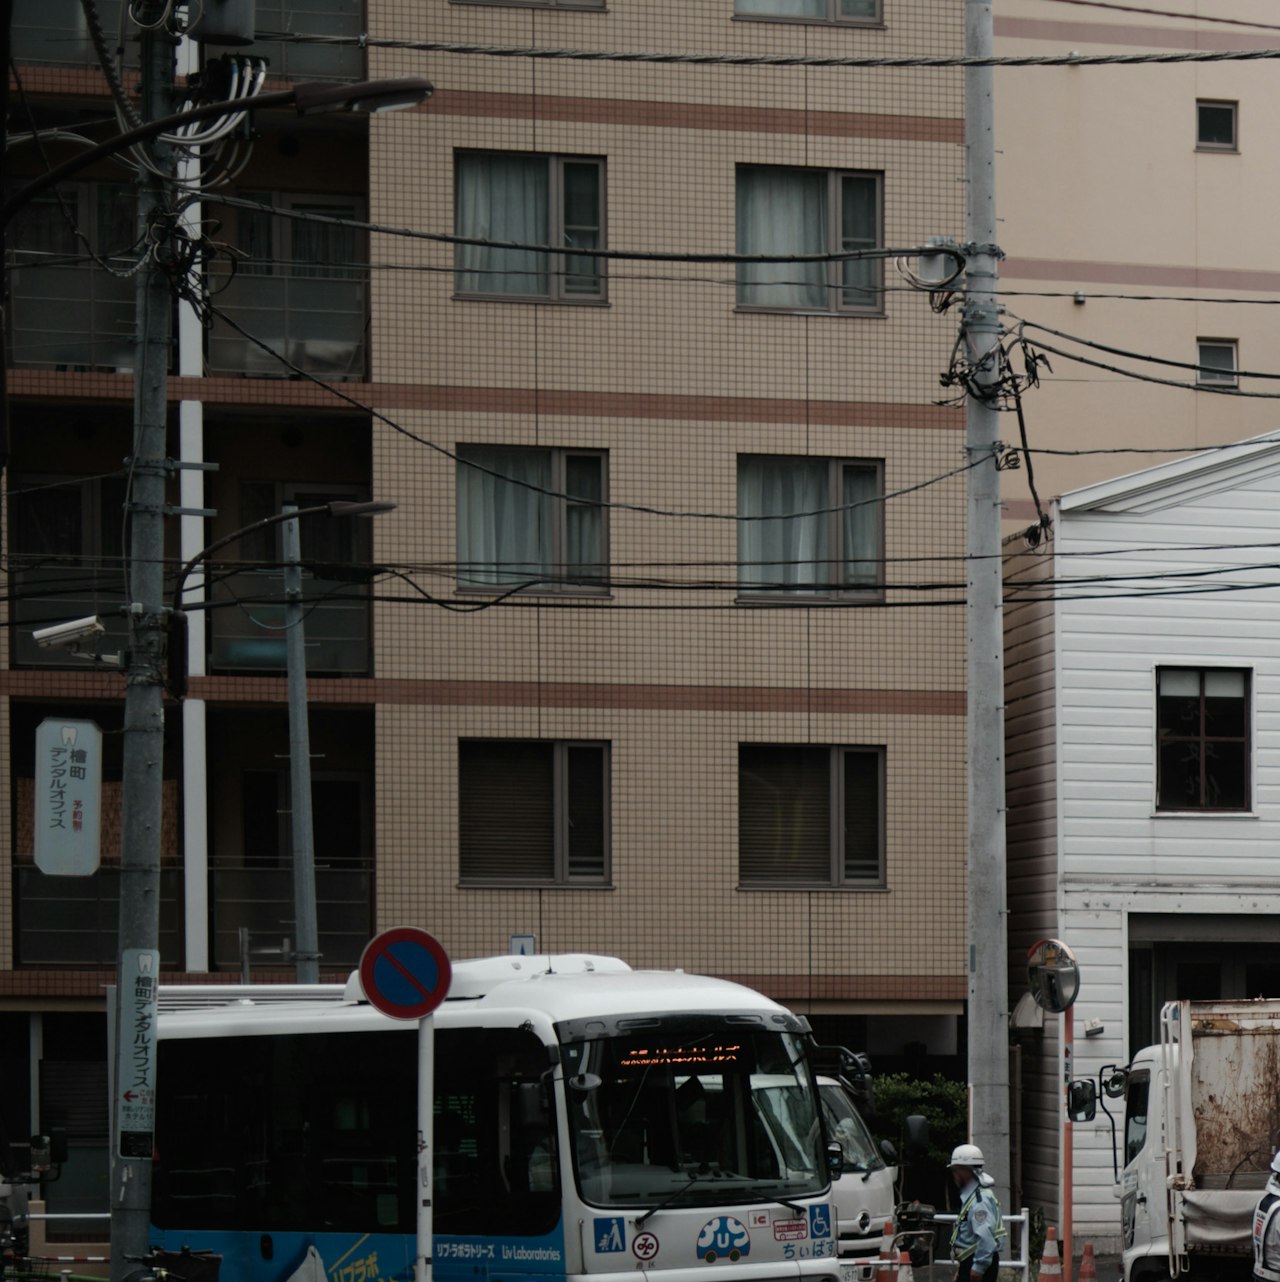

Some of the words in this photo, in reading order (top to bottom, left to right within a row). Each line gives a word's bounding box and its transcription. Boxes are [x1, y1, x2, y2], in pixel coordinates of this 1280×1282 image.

[49, 747, 67, 829] デンタルオフィス
